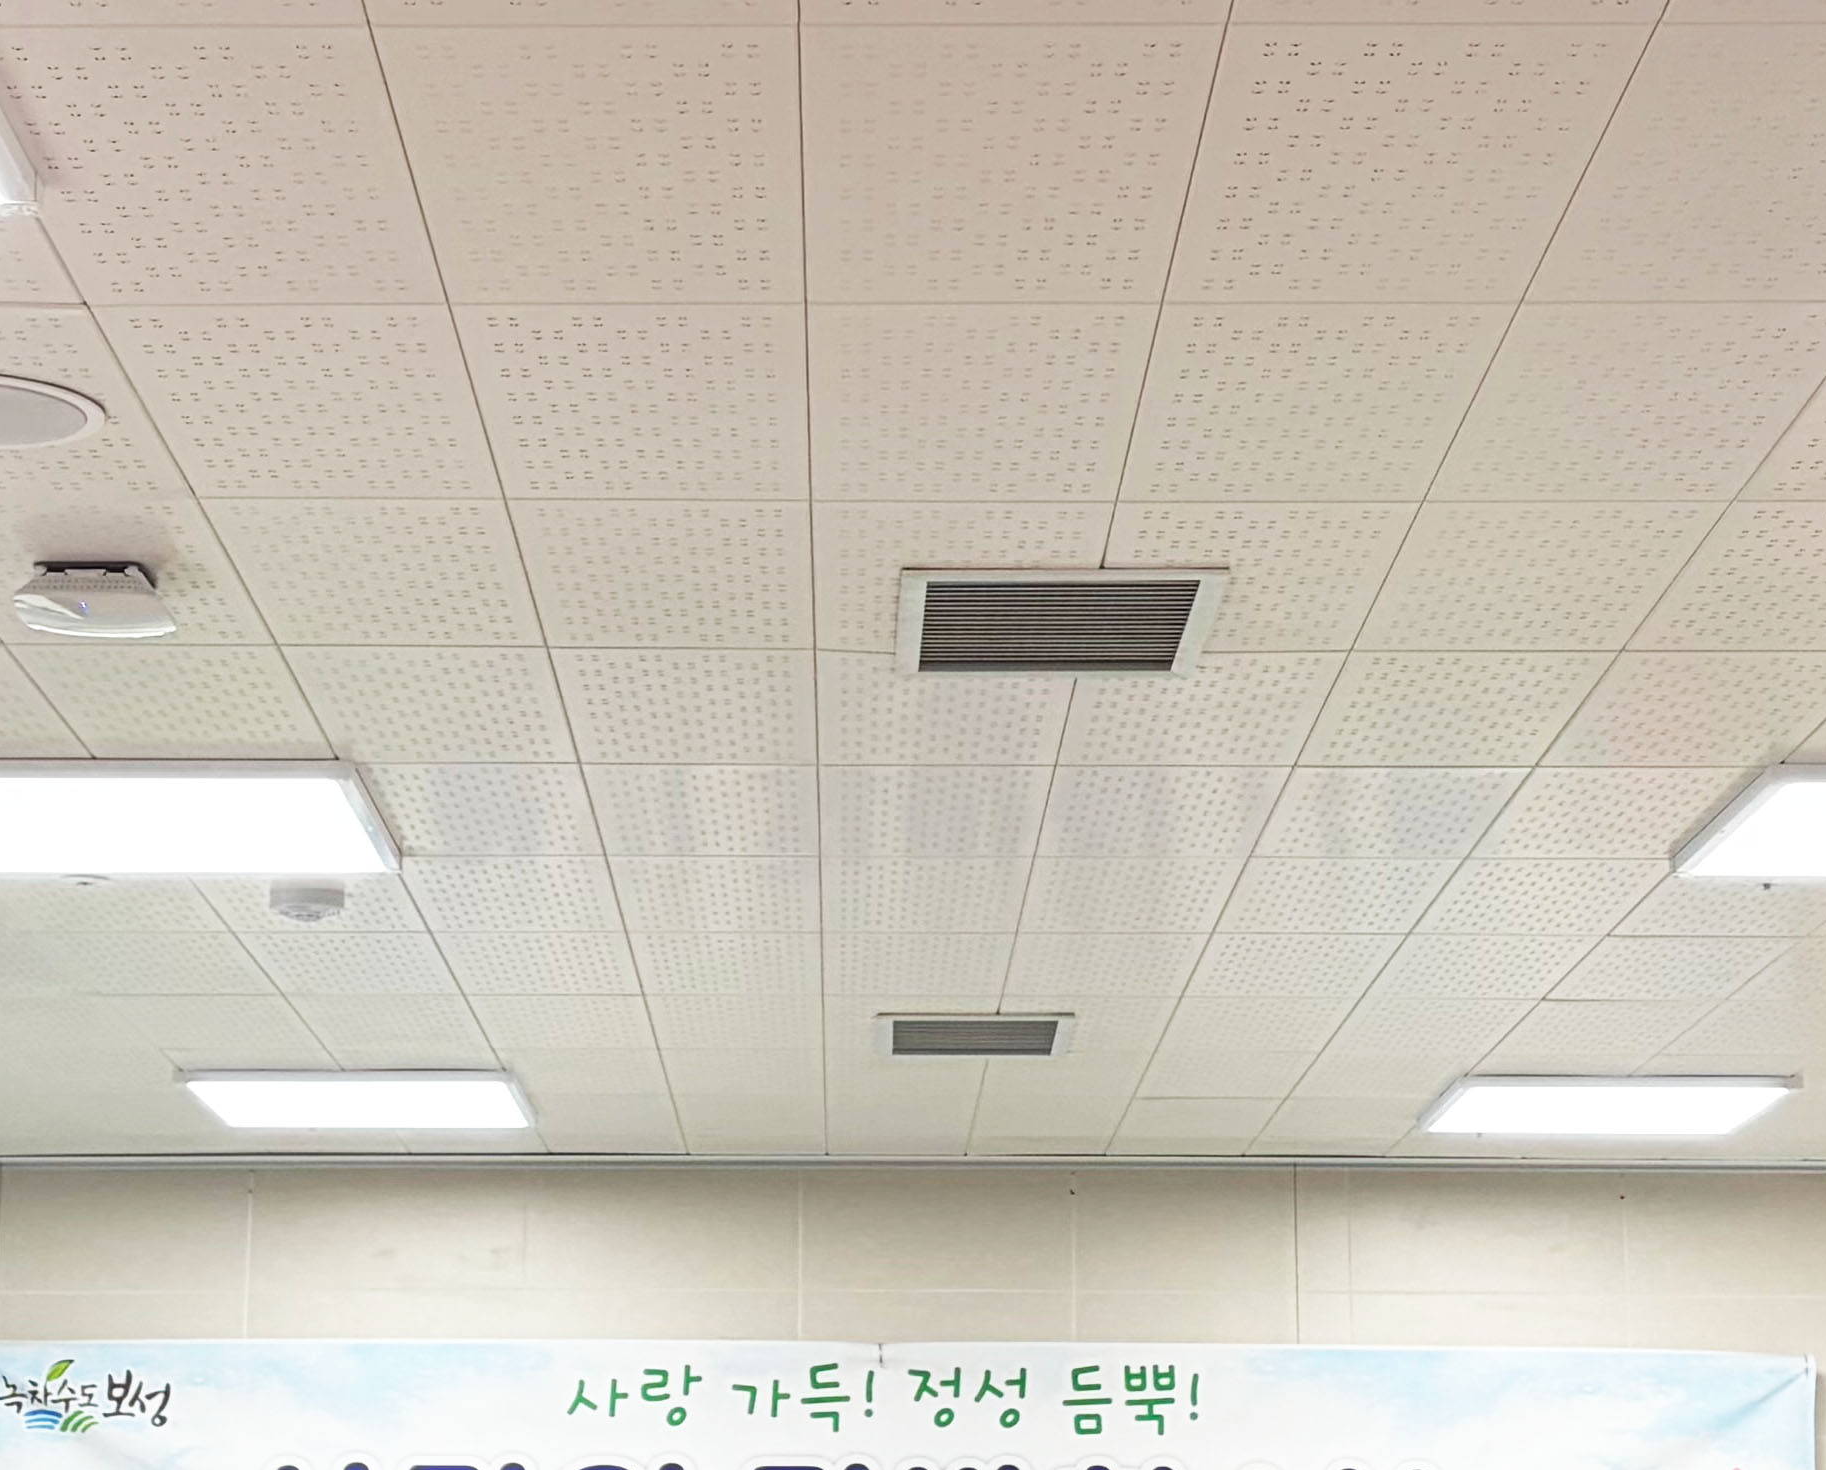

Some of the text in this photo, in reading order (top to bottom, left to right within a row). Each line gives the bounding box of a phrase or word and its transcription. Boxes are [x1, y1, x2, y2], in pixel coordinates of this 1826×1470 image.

[102, 1369, 172, 1427] 보성
[567, 1362, 1201, 1436] 사랑 가득! 정성 듬뿍!
